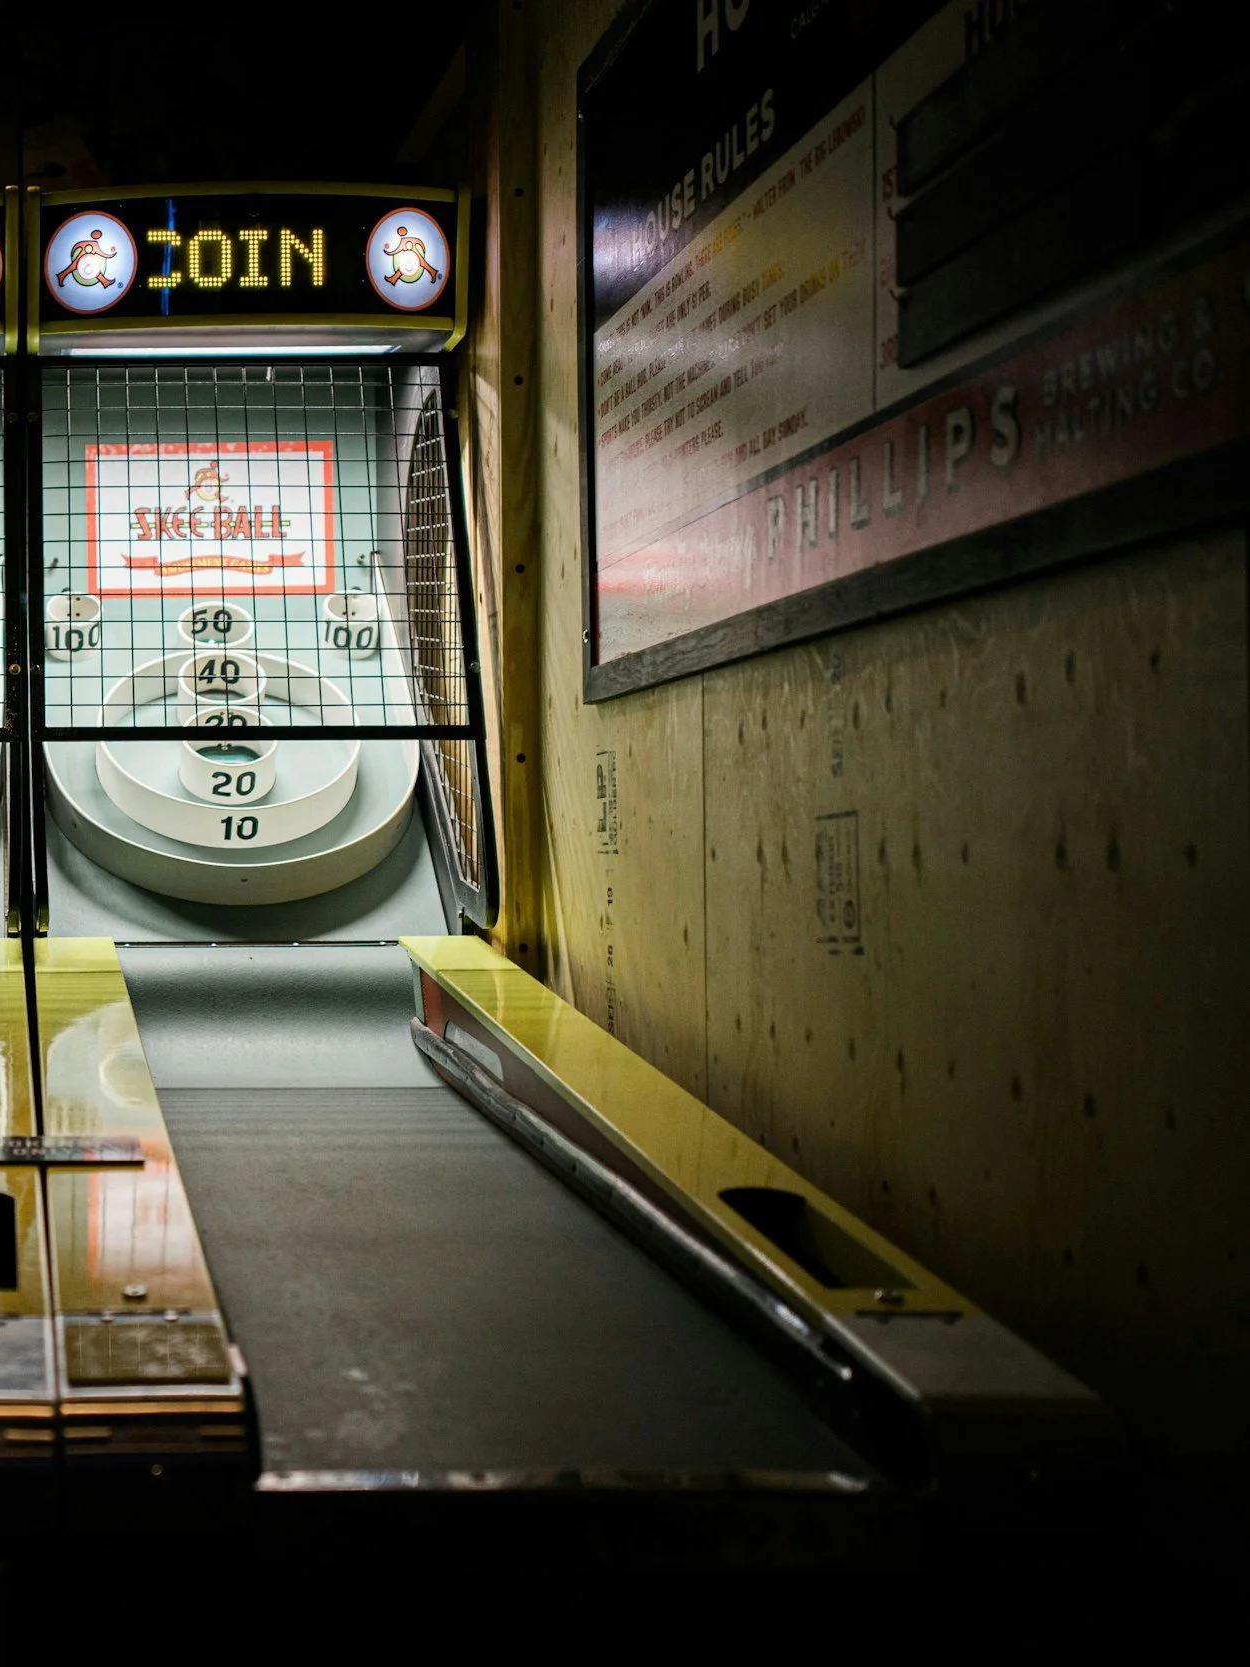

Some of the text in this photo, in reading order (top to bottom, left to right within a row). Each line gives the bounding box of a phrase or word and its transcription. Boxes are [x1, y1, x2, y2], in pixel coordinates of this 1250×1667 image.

[631, 87, 776, 268] HOUSE RULES
[799, 151, 811, 179] THE
[1041, 310, 1180, 407] BREWING
[763, 425, 775, 450] DAY
[765, 384, 1022, 562] PHILLIPS
[190, 609, 233, 635] 50
[324, 620, 374, 651] 100
[52, 624, 100, 653] 100
[198, 659, 240, 685] 40
[211, 771, 256, 797] 20
[220, 815, 259, 841] 10
